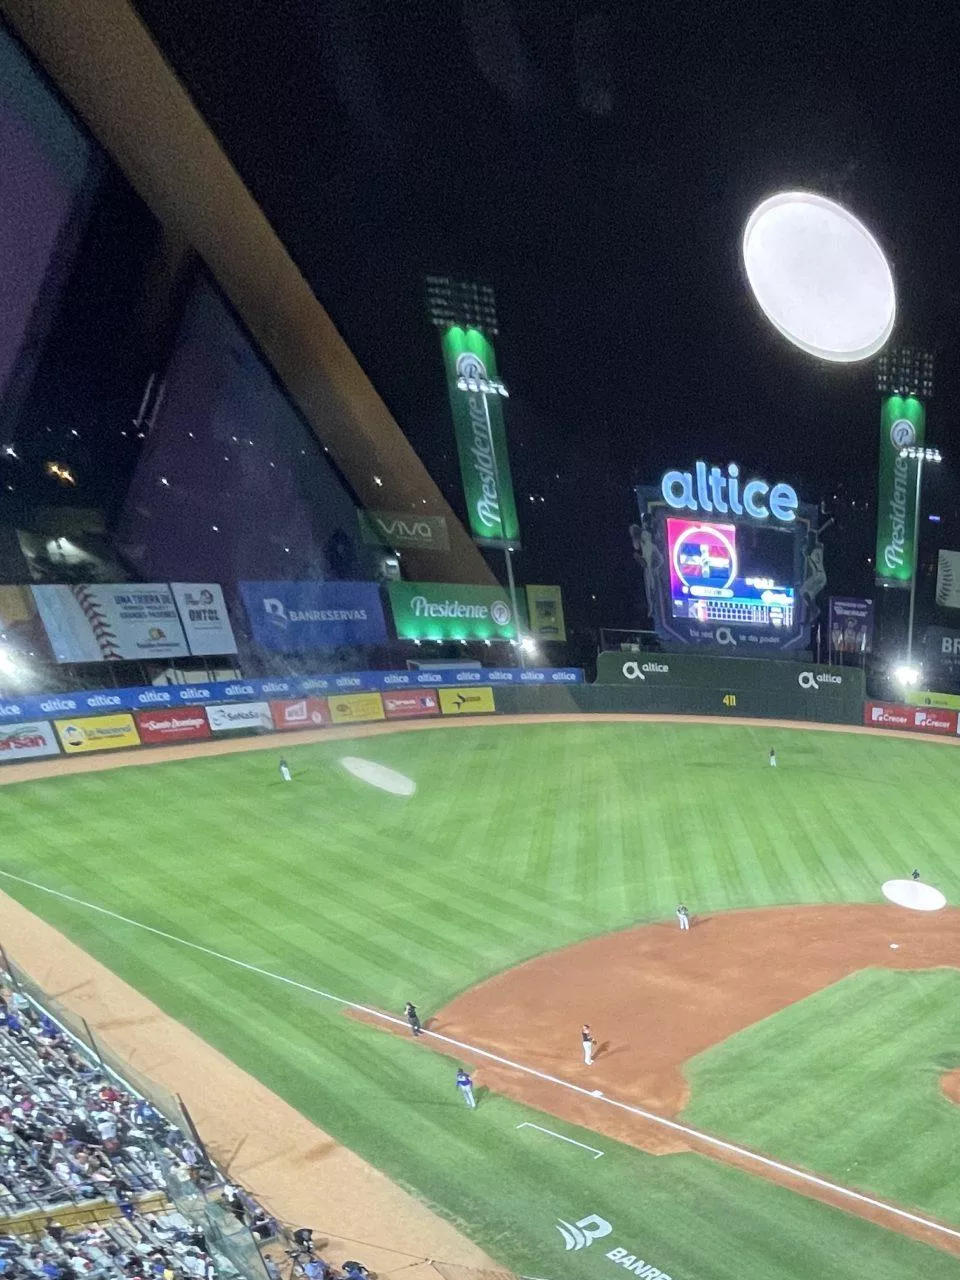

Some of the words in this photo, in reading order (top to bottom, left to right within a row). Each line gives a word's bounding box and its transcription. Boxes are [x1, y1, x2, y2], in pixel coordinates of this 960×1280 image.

[661, 460, 799, 522] altice
[885, 456, 909, 569] Presidente
[410, 596, 488, 620] Presidente
[289, 608, 368, 622] BANRESERVAS
[642, 662, 669, 673] altice
[384, 674, 409, 684] altice
[417, 672, 442, 682] altice
[456, 671, 481, 681] altice
[488, 671, 513, 681] altice
[520, 671, 545, 681] altice
[552, 671, 576, 681] altice
[817, 673, 842, 685] altice
[225, 684, 254, 696] altice
[262, 681, 289, 693] altice
[138, 690, 170, 703] altice
[180, 688, 211, 700] altice
[87, 694, 121, 707] altice
